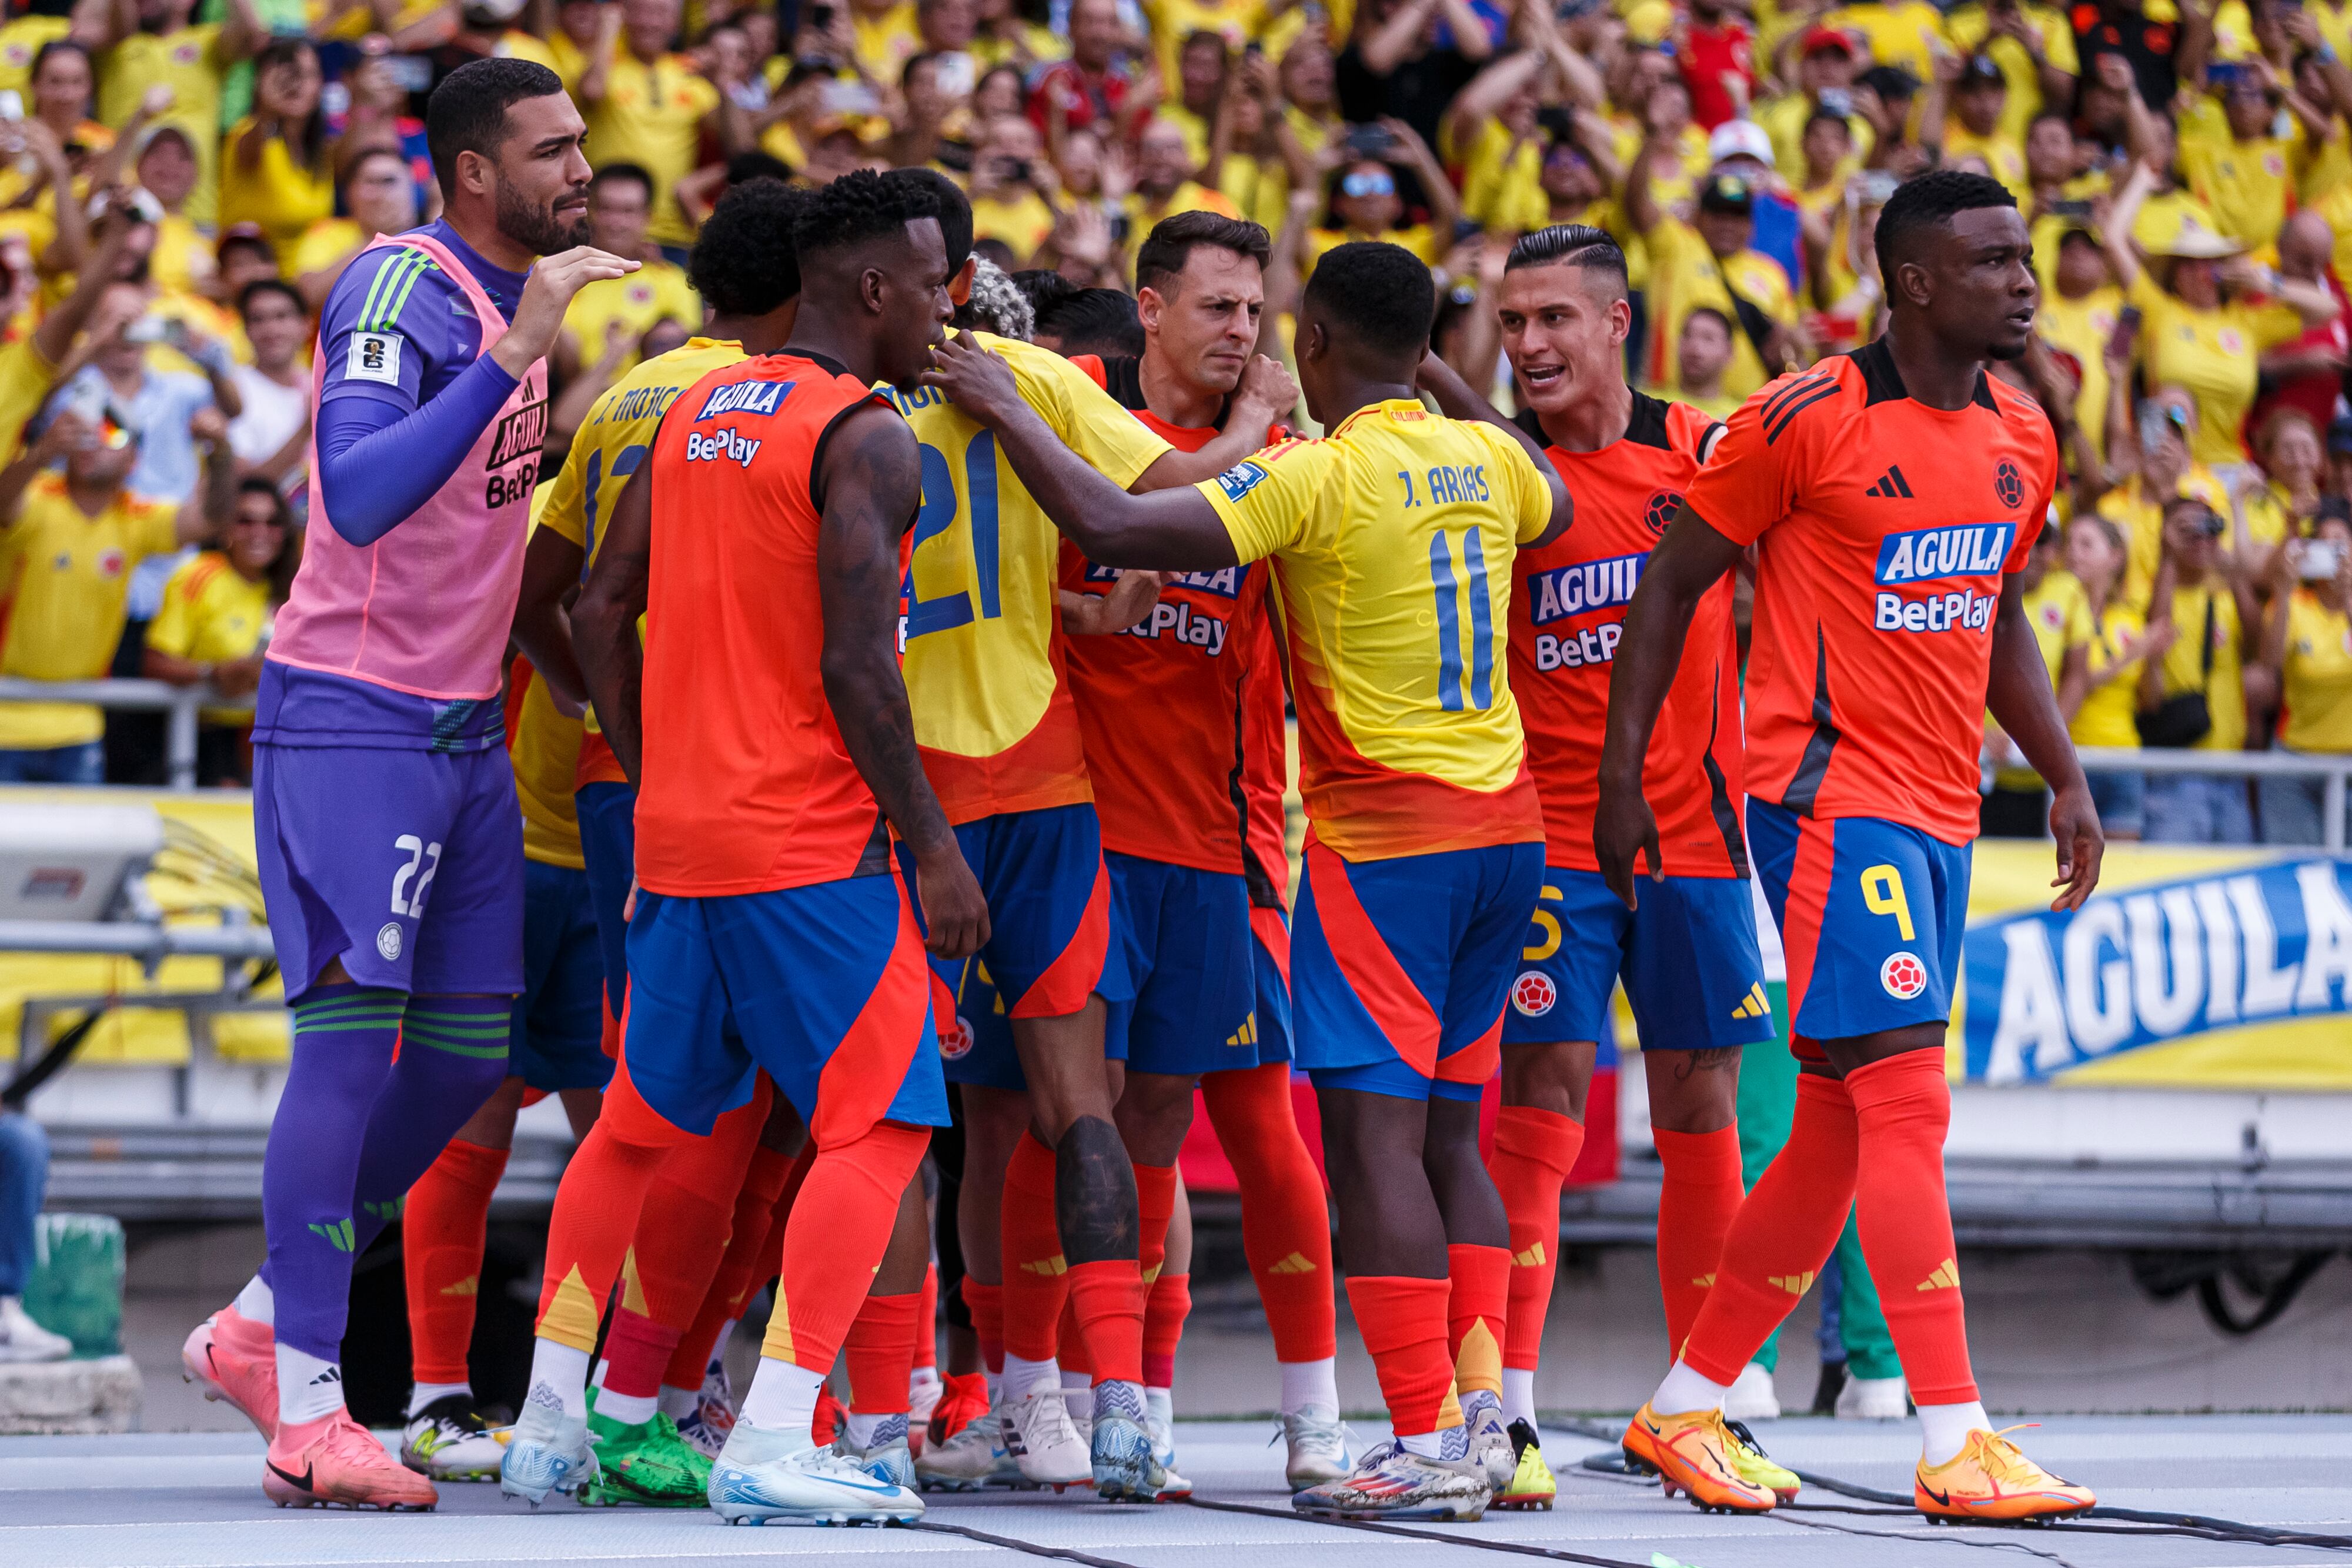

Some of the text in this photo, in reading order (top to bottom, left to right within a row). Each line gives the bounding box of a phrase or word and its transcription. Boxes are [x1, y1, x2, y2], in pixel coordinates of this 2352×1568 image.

[612, 386, 688, 422] MOJIC
[698, 381, 784, 420] AGUILA
[1390, 410, 1428, 422] COLOMBI
[686, 427, 762, 469] BePlay
[1398, 465, 1490, 509] J. ARIAS
[906, 427, 1002, 640] 21
[1882, 527, 2007, 581] AGUILA
[1084, 592, 1230, 656] Play
[1429, 526, 1494, 712] 11
[1875, 589, 1996, 634] BetPlay
[391, 834, 442, 920] 22
[1860, 864, 1915, 941] 9
[1985, 862, 2352, 1086] AGUILA
